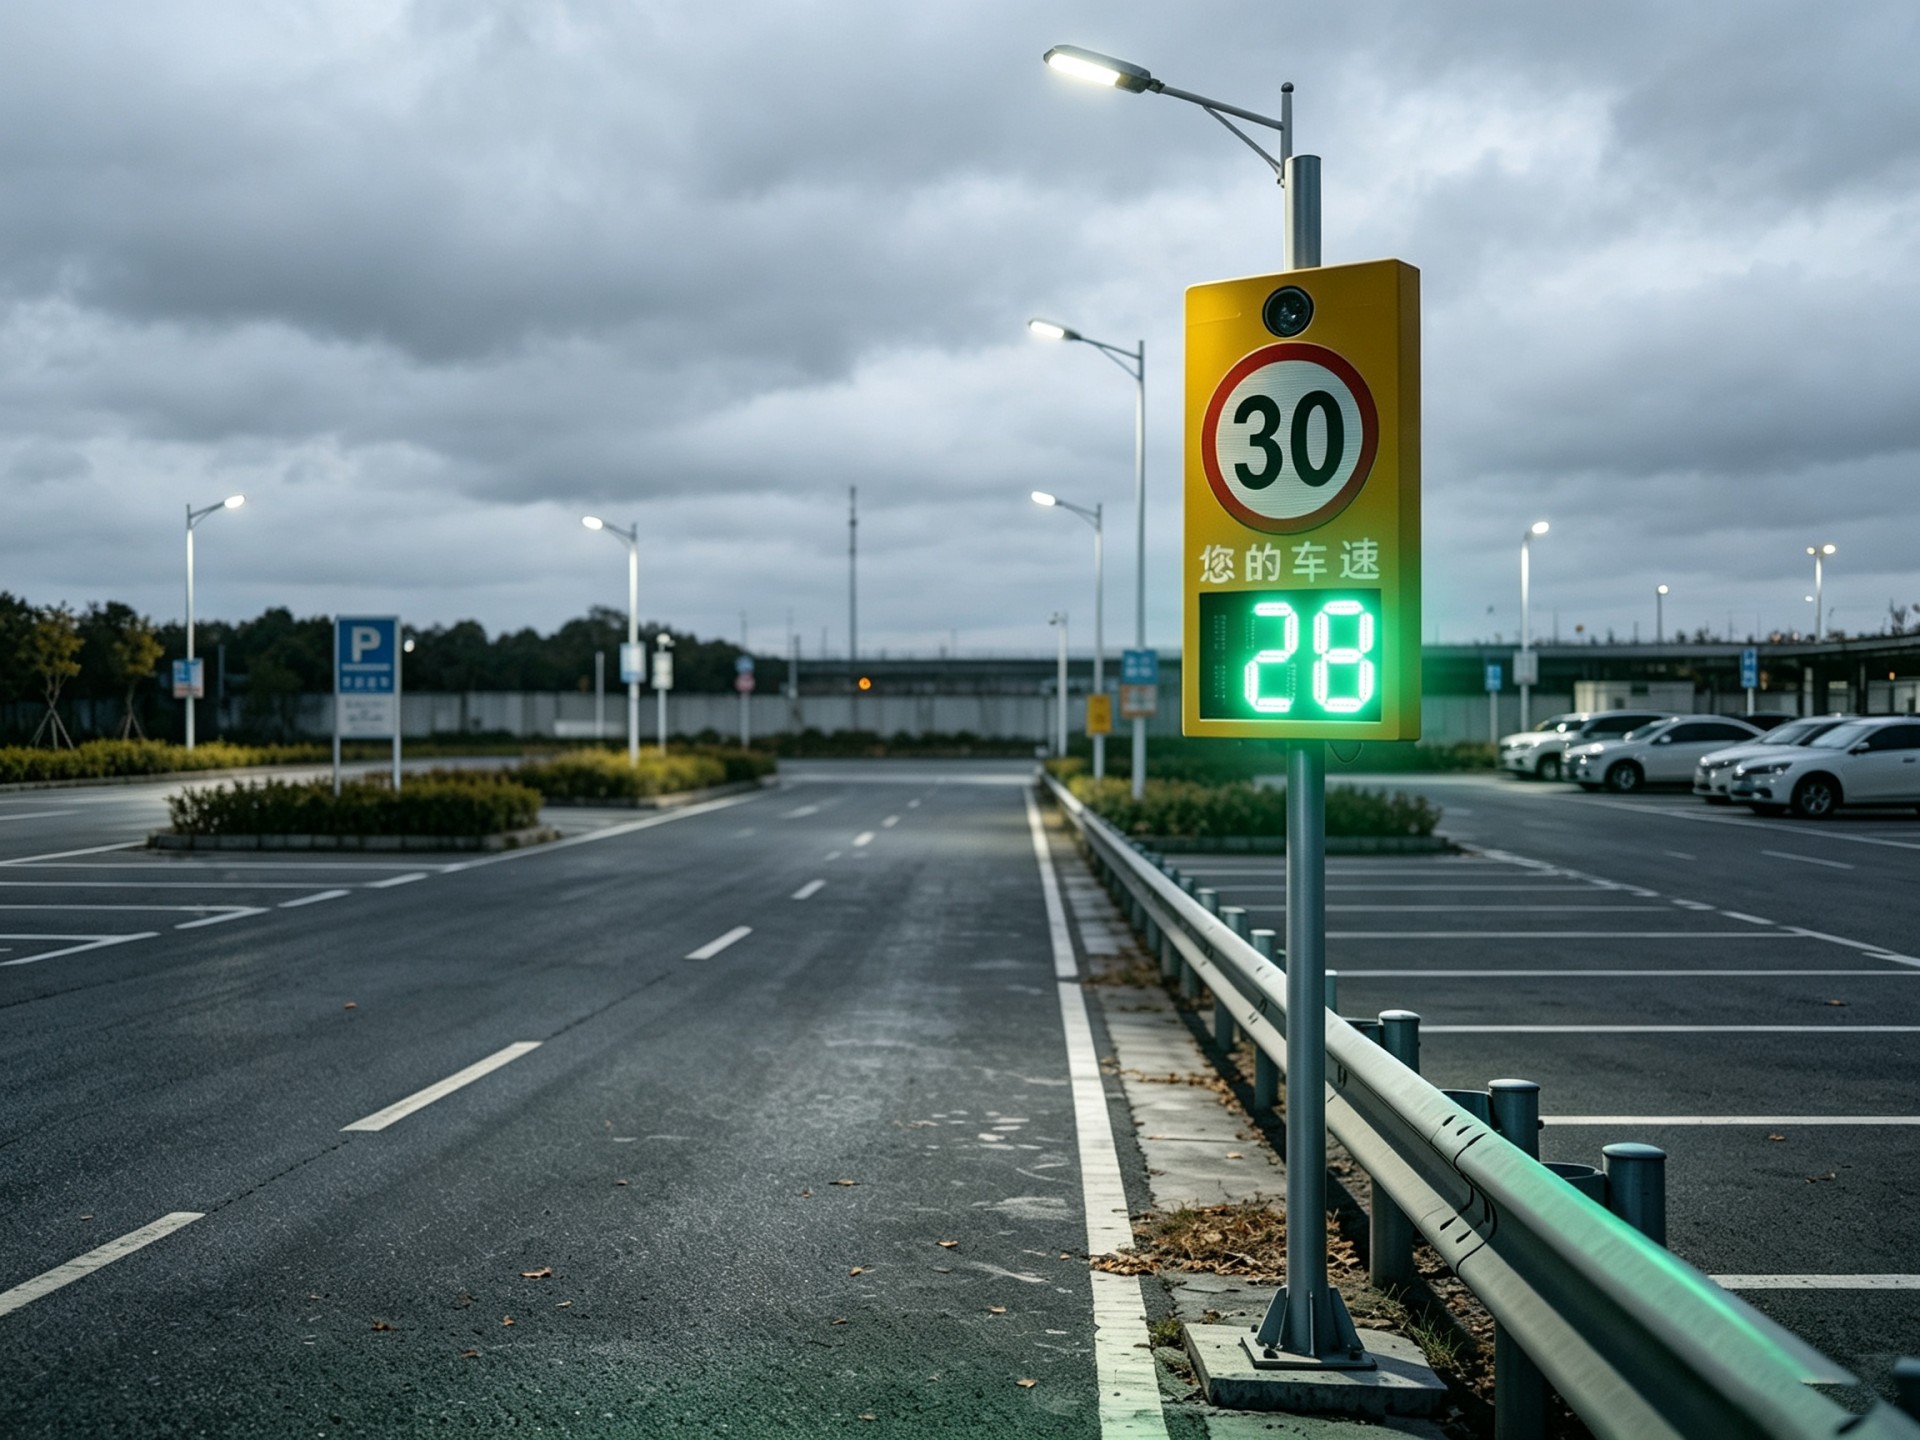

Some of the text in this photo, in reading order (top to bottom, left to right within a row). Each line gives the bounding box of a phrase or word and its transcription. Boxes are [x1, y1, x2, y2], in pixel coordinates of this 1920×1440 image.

[1234, 390, 1344, 490] 30
[1199, 537, 1380, 583] 您的车速
[351, 626, 381, 662] P
[1244, 600, 1374, 713] 28
